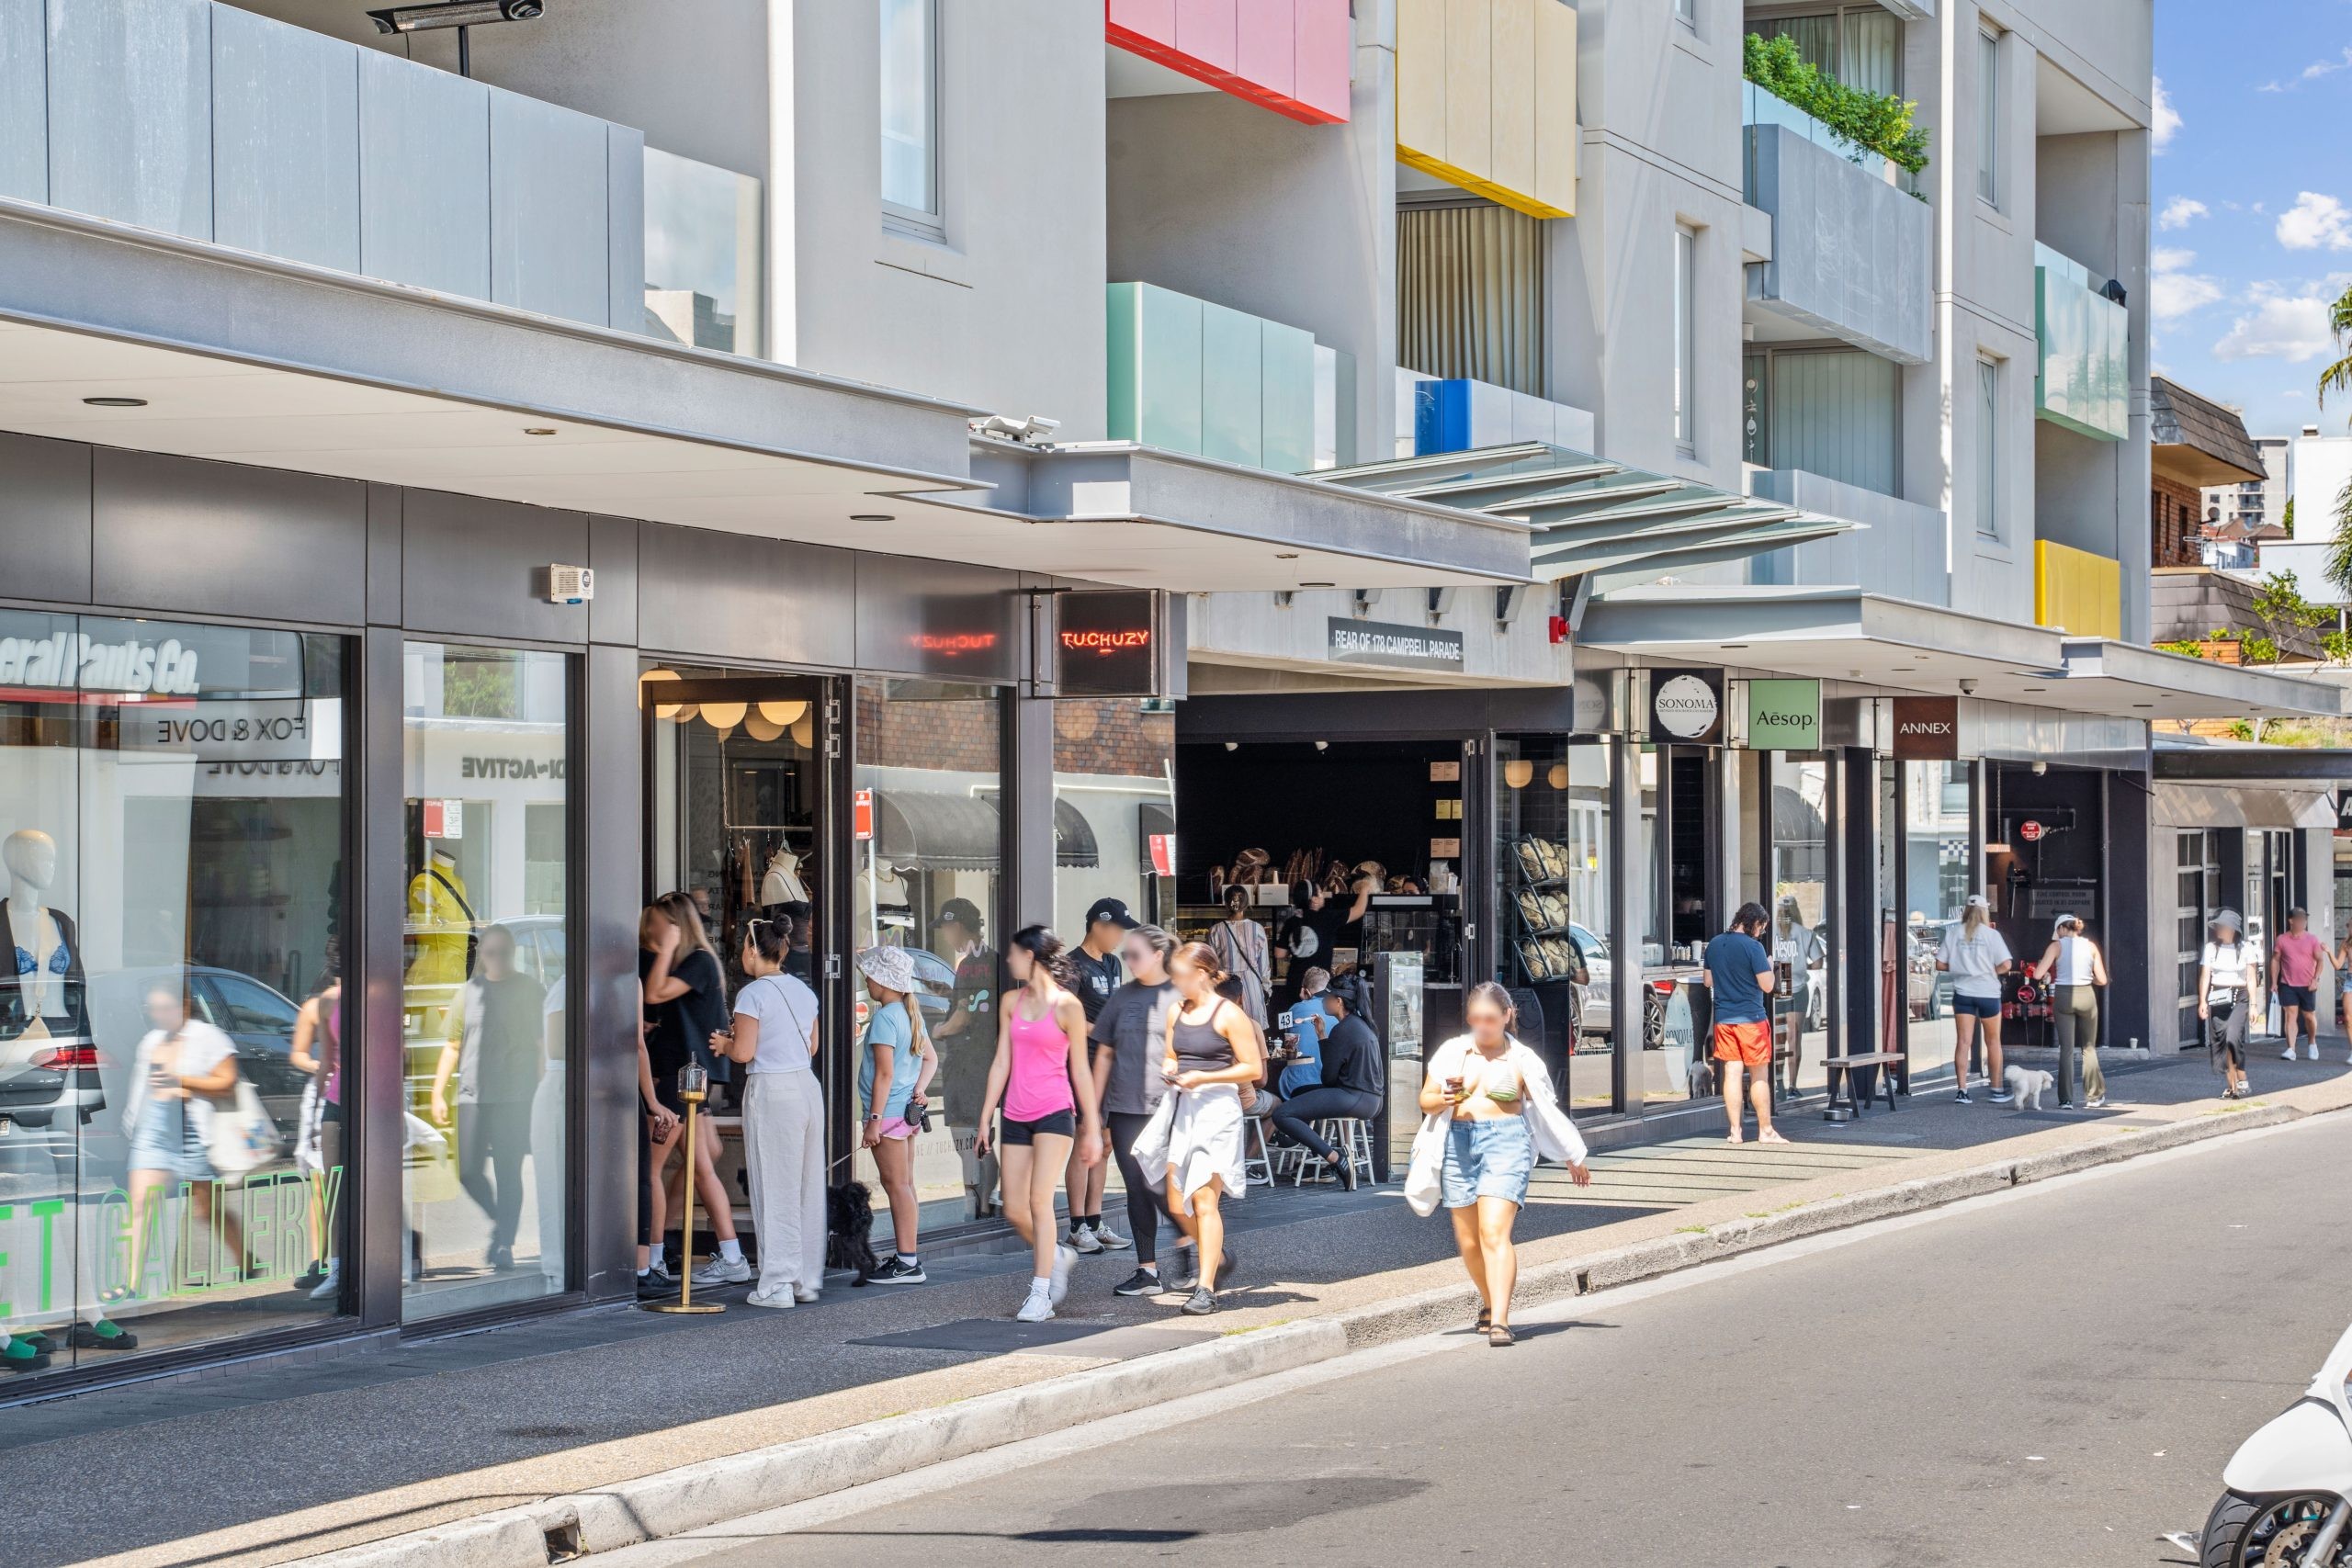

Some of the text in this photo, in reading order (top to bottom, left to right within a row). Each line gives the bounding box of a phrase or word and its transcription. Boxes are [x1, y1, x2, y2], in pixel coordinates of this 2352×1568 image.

[1061, 630, 1149, 646] TUCHUZY
[1335, 630, 1460, 660] REAR OF 178 CAMPBELL PARADE
[1658, 698, 1714, 709] SONOMA
[1899, 722, 1951, 734] ANNEX
[1280, 1015, 1291, 1026] 43
[96, 1165, 344, 1304] GALLERY
